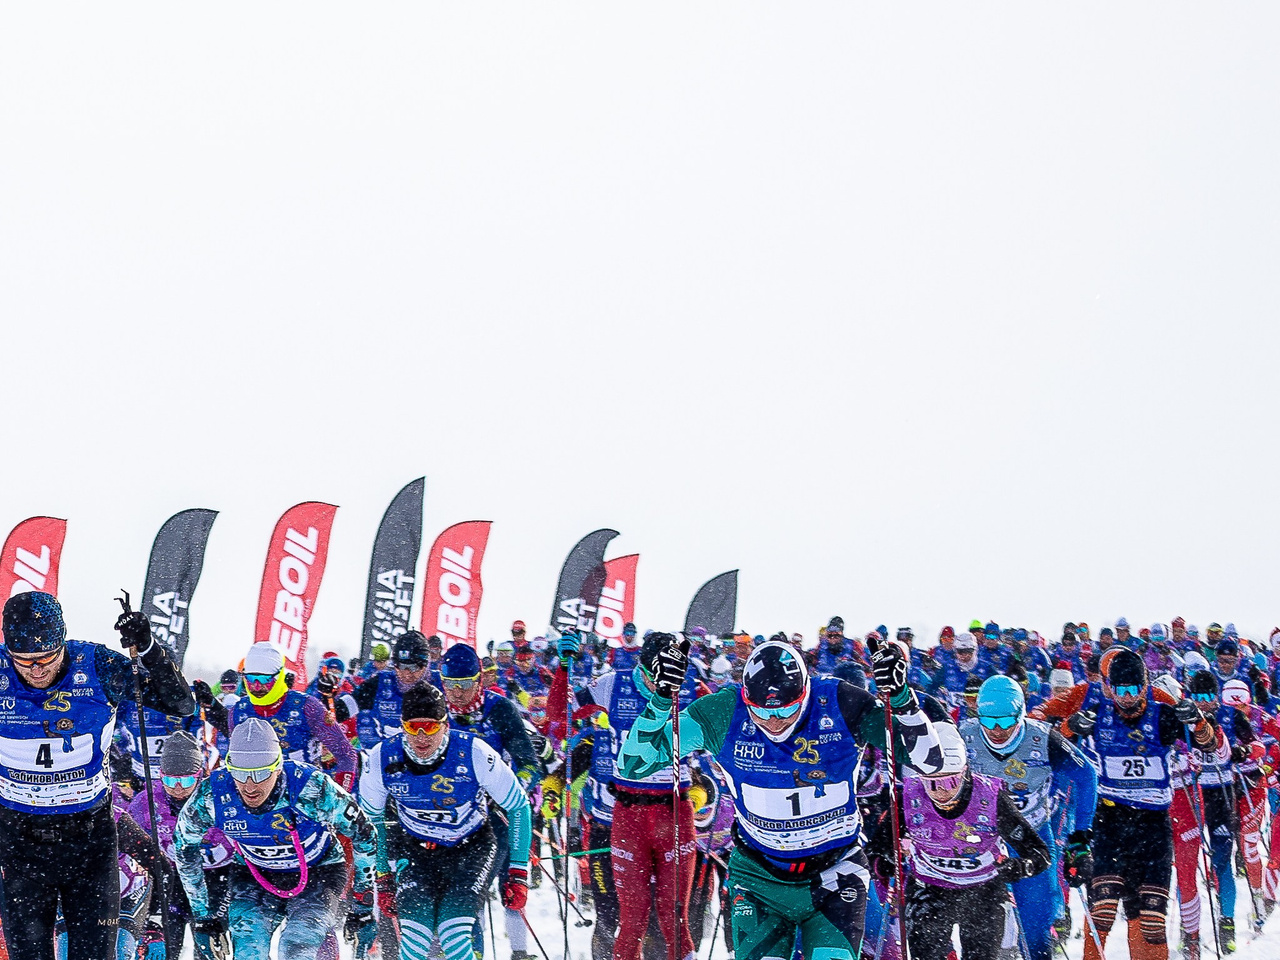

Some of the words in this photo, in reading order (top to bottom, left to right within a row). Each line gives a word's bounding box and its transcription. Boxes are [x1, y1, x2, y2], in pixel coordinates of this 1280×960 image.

[44, 690, 71, 712] 25
[35, 743, 54, 768] 4
[792, 737, 820, 764] 25
[1122, 759, 1145, 778] 25
[430, 774, 455, 794] 25
[786, 792, 801, 817] 1
